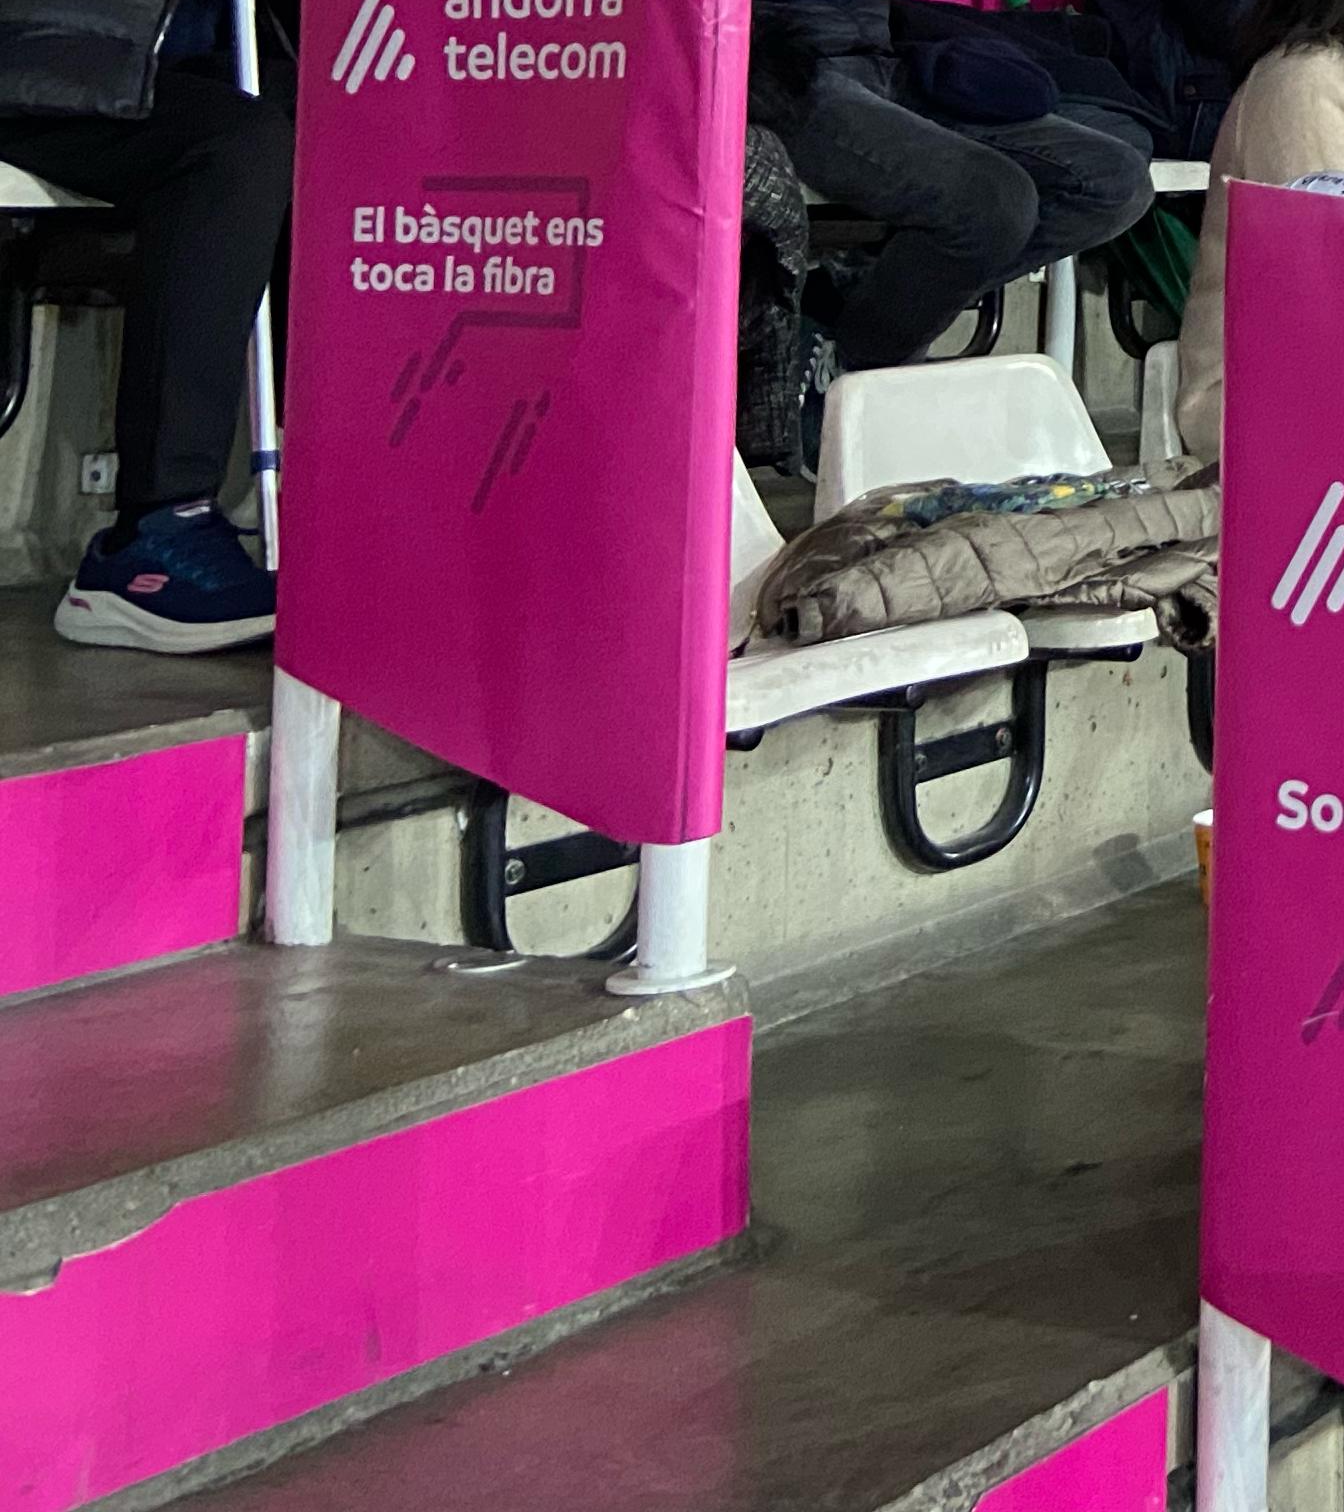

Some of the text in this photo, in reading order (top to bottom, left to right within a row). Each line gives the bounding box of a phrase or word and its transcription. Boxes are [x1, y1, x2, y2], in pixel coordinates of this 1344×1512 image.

[444, 31, 626, 80] telecom
[353, 203, 604, 253] El bàsquet ens
[350, 255, 555, 295] toca la fibra
